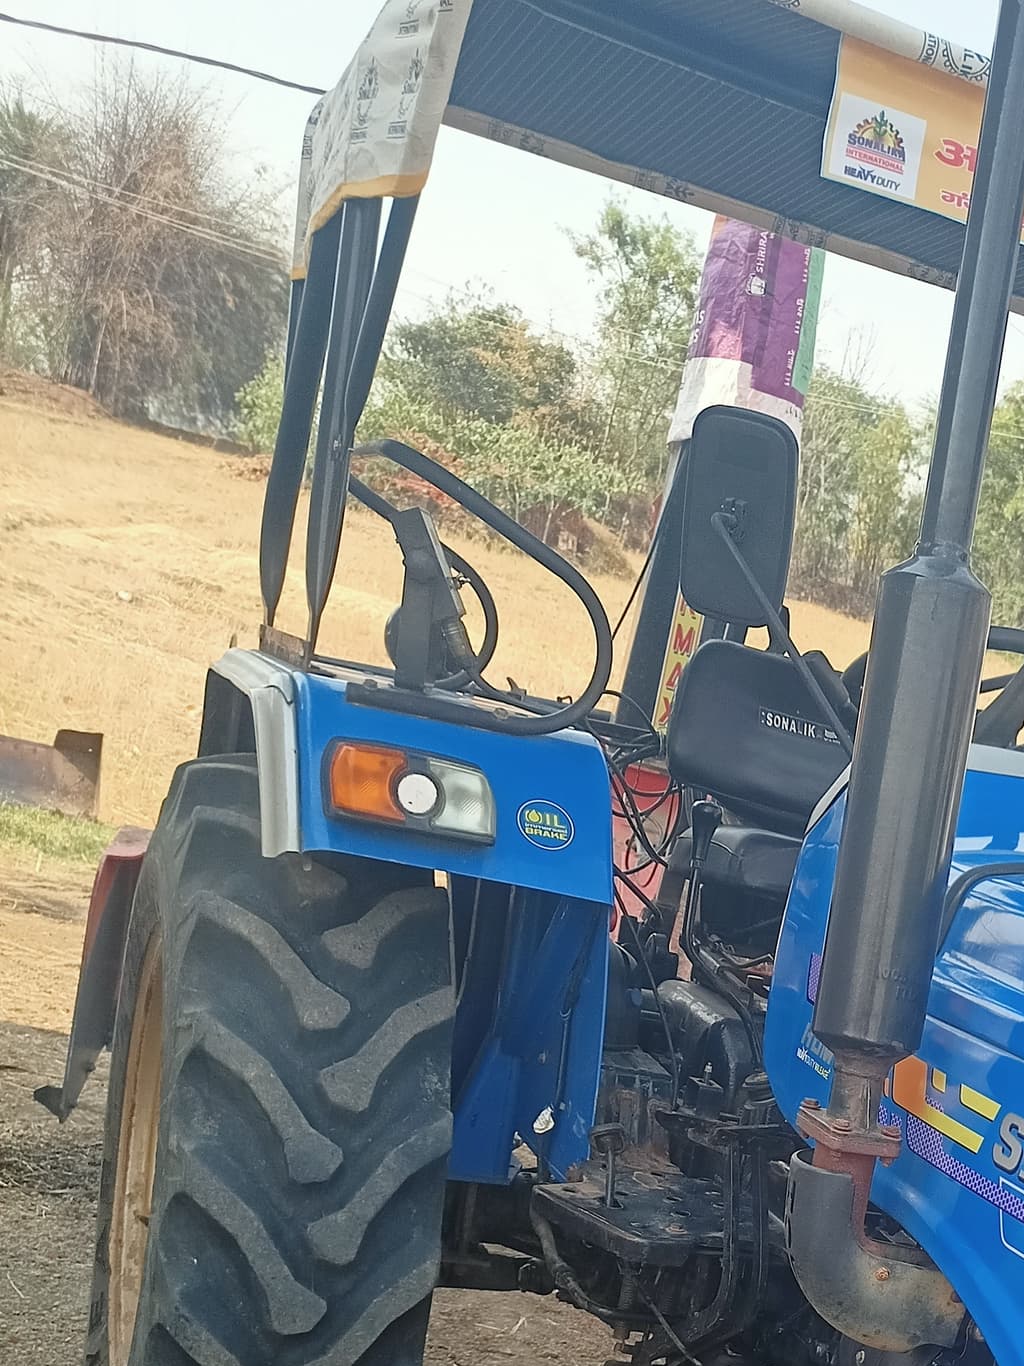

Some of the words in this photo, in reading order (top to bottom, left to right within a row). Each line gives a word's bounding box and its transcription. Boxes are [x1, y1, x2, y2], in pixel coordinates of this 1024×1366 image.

[847, 132, 906, 163] SONALIKA
[845, 149, 905, 174] INTERNATIONAL
[525, 809, 567, 829] OIL
[525, 827, 568, 841] BRAKE
